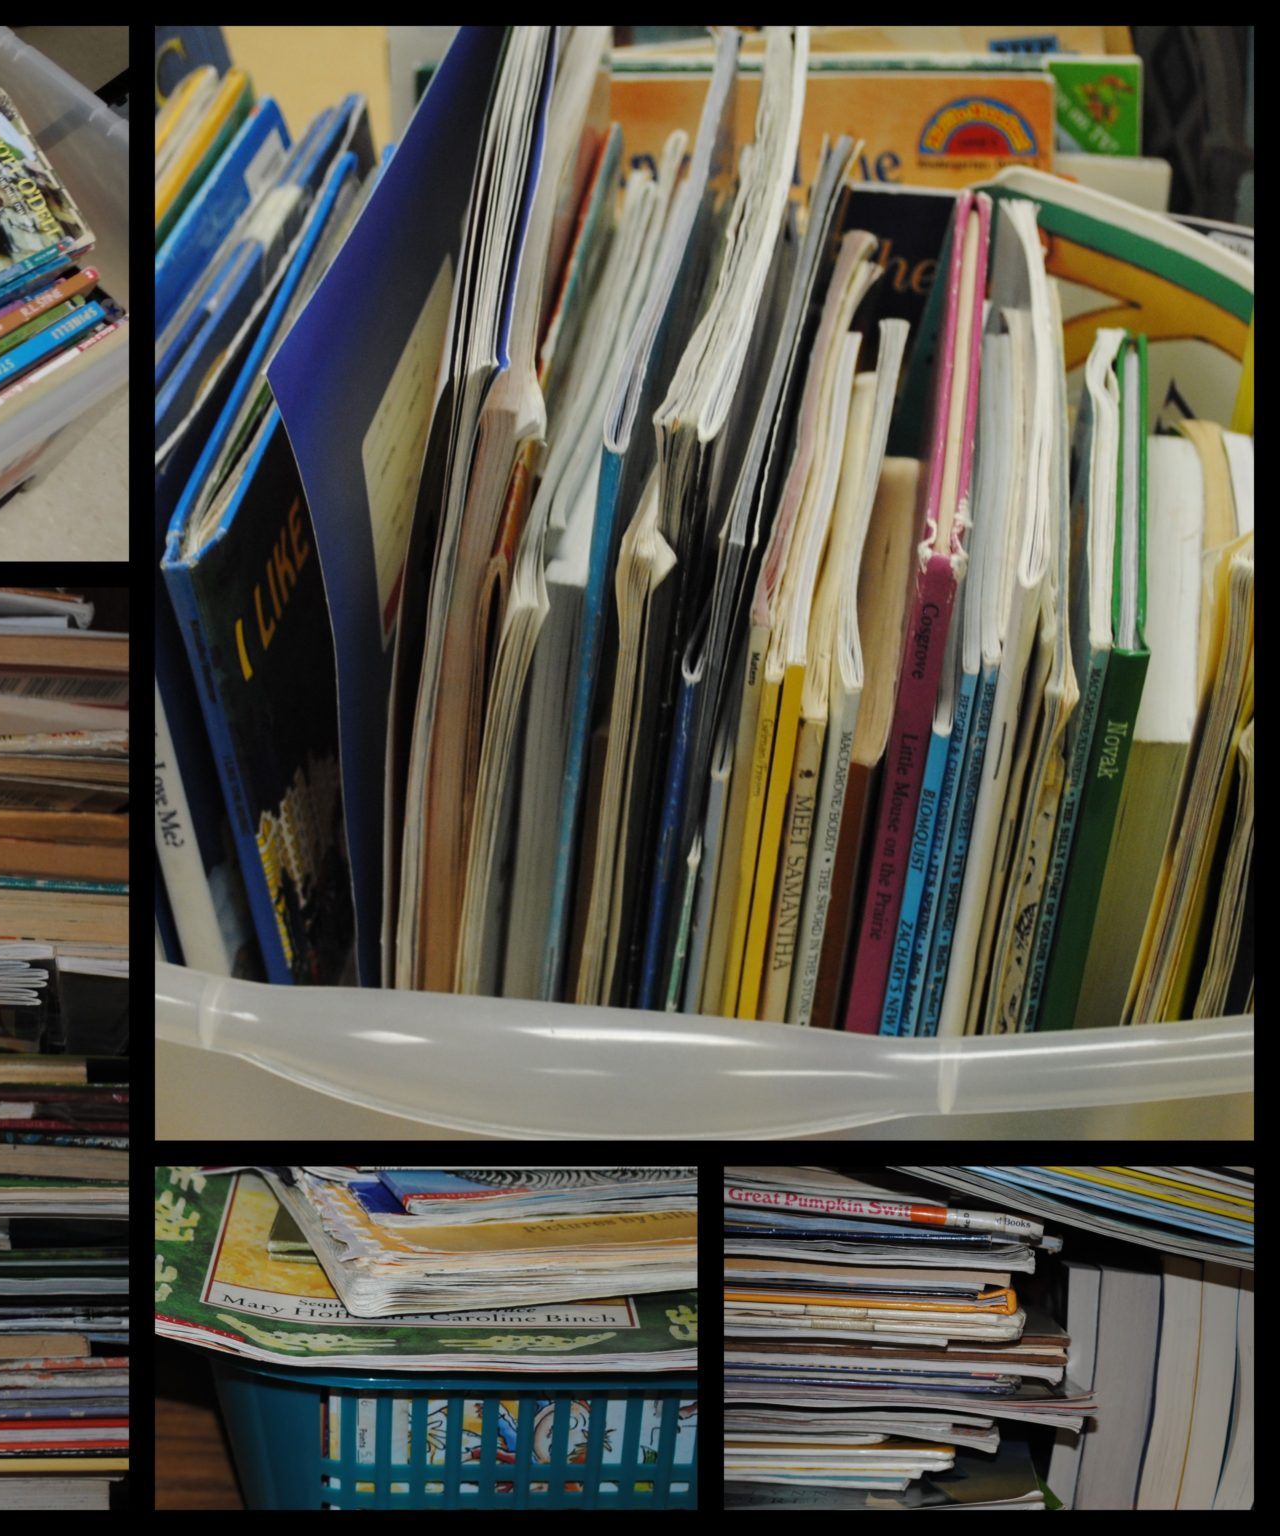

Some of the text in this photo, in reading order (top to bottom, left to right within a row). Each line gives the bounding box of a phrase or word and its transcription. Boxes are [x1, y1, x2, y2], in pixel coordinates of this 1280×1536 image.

[48, 304, 98, 340] SPINELLI
[252, 494, 312, 651] LIKE
[952, 694, 970, 741] BERGER
[1095, 718, 1129, 781] Novak
[866, 602, 940, 944] Cosgrove Little Mouse on the Prairie
[157, 808, 185, 850] Me?
[1060, 799, 1075, 825] THE
[1053, 826, 1070, 859] SILLY
[771, 793, 813, 973] MEET SAMANTHA
[816, 868, 832, 894] THE
[925, 863, 940, 888] IT'S
[949, 853, 962, 879] IT'S
[1045, 862, 1063, 898] STORY
[809, 894, 828, 937] SWORD
[883, 788, 935, 1028] BLOMQUIST ZACHARY'S NEW
[916, 891, 935, 942] SPRING!
[940, 883, 957, 931] SPRING!
[807, 937, 821, 951] IN
[804, 951, 819, 974] THE
[908, 952, 923, 980] Hello
[797, 975, 815, 1017] STONE
[727, 1186, 912, 1218] Great Pumpkin Swit
[523, 1213, 644, 1234] Pictures by
[1003, 1217, 1031, 1228] Books
[222, 1294, 616, 1323] Mary Caroline Binch
